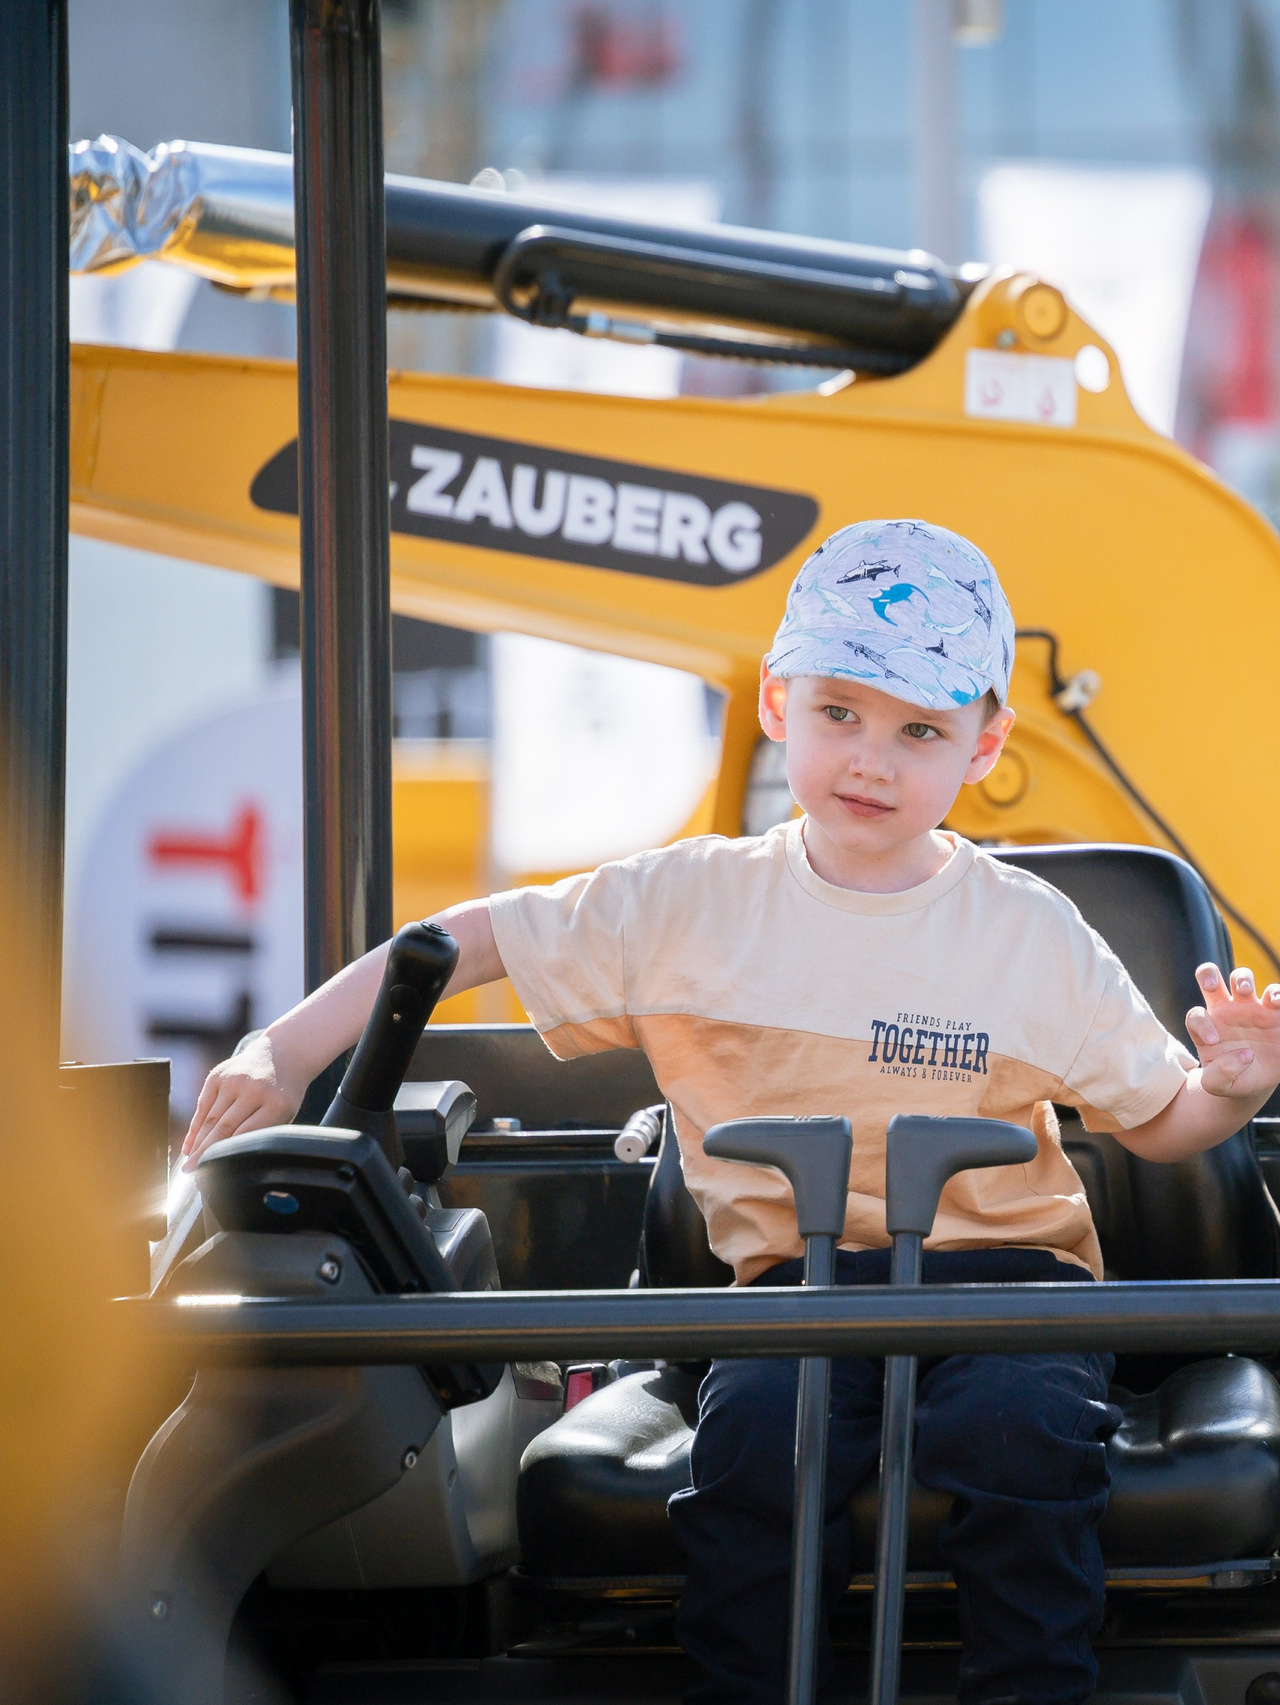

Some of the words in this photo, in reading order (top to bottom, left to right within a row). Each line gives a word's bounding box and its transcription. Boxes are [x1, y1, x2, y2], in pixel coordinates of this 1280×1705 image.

[407, 444, 764, 573] ZAUBERG
[896, 1012, 941, 1028] FRIENDS
[946, 1020, 972, 1031] PLAY
[868, 1019, 990, 1075] TOGETHER
[880, 1066, 917, 1078] ALWAYS
[921, 1068, 927, 1079] &
[931, 1069, 973, 1083] FOREVER
